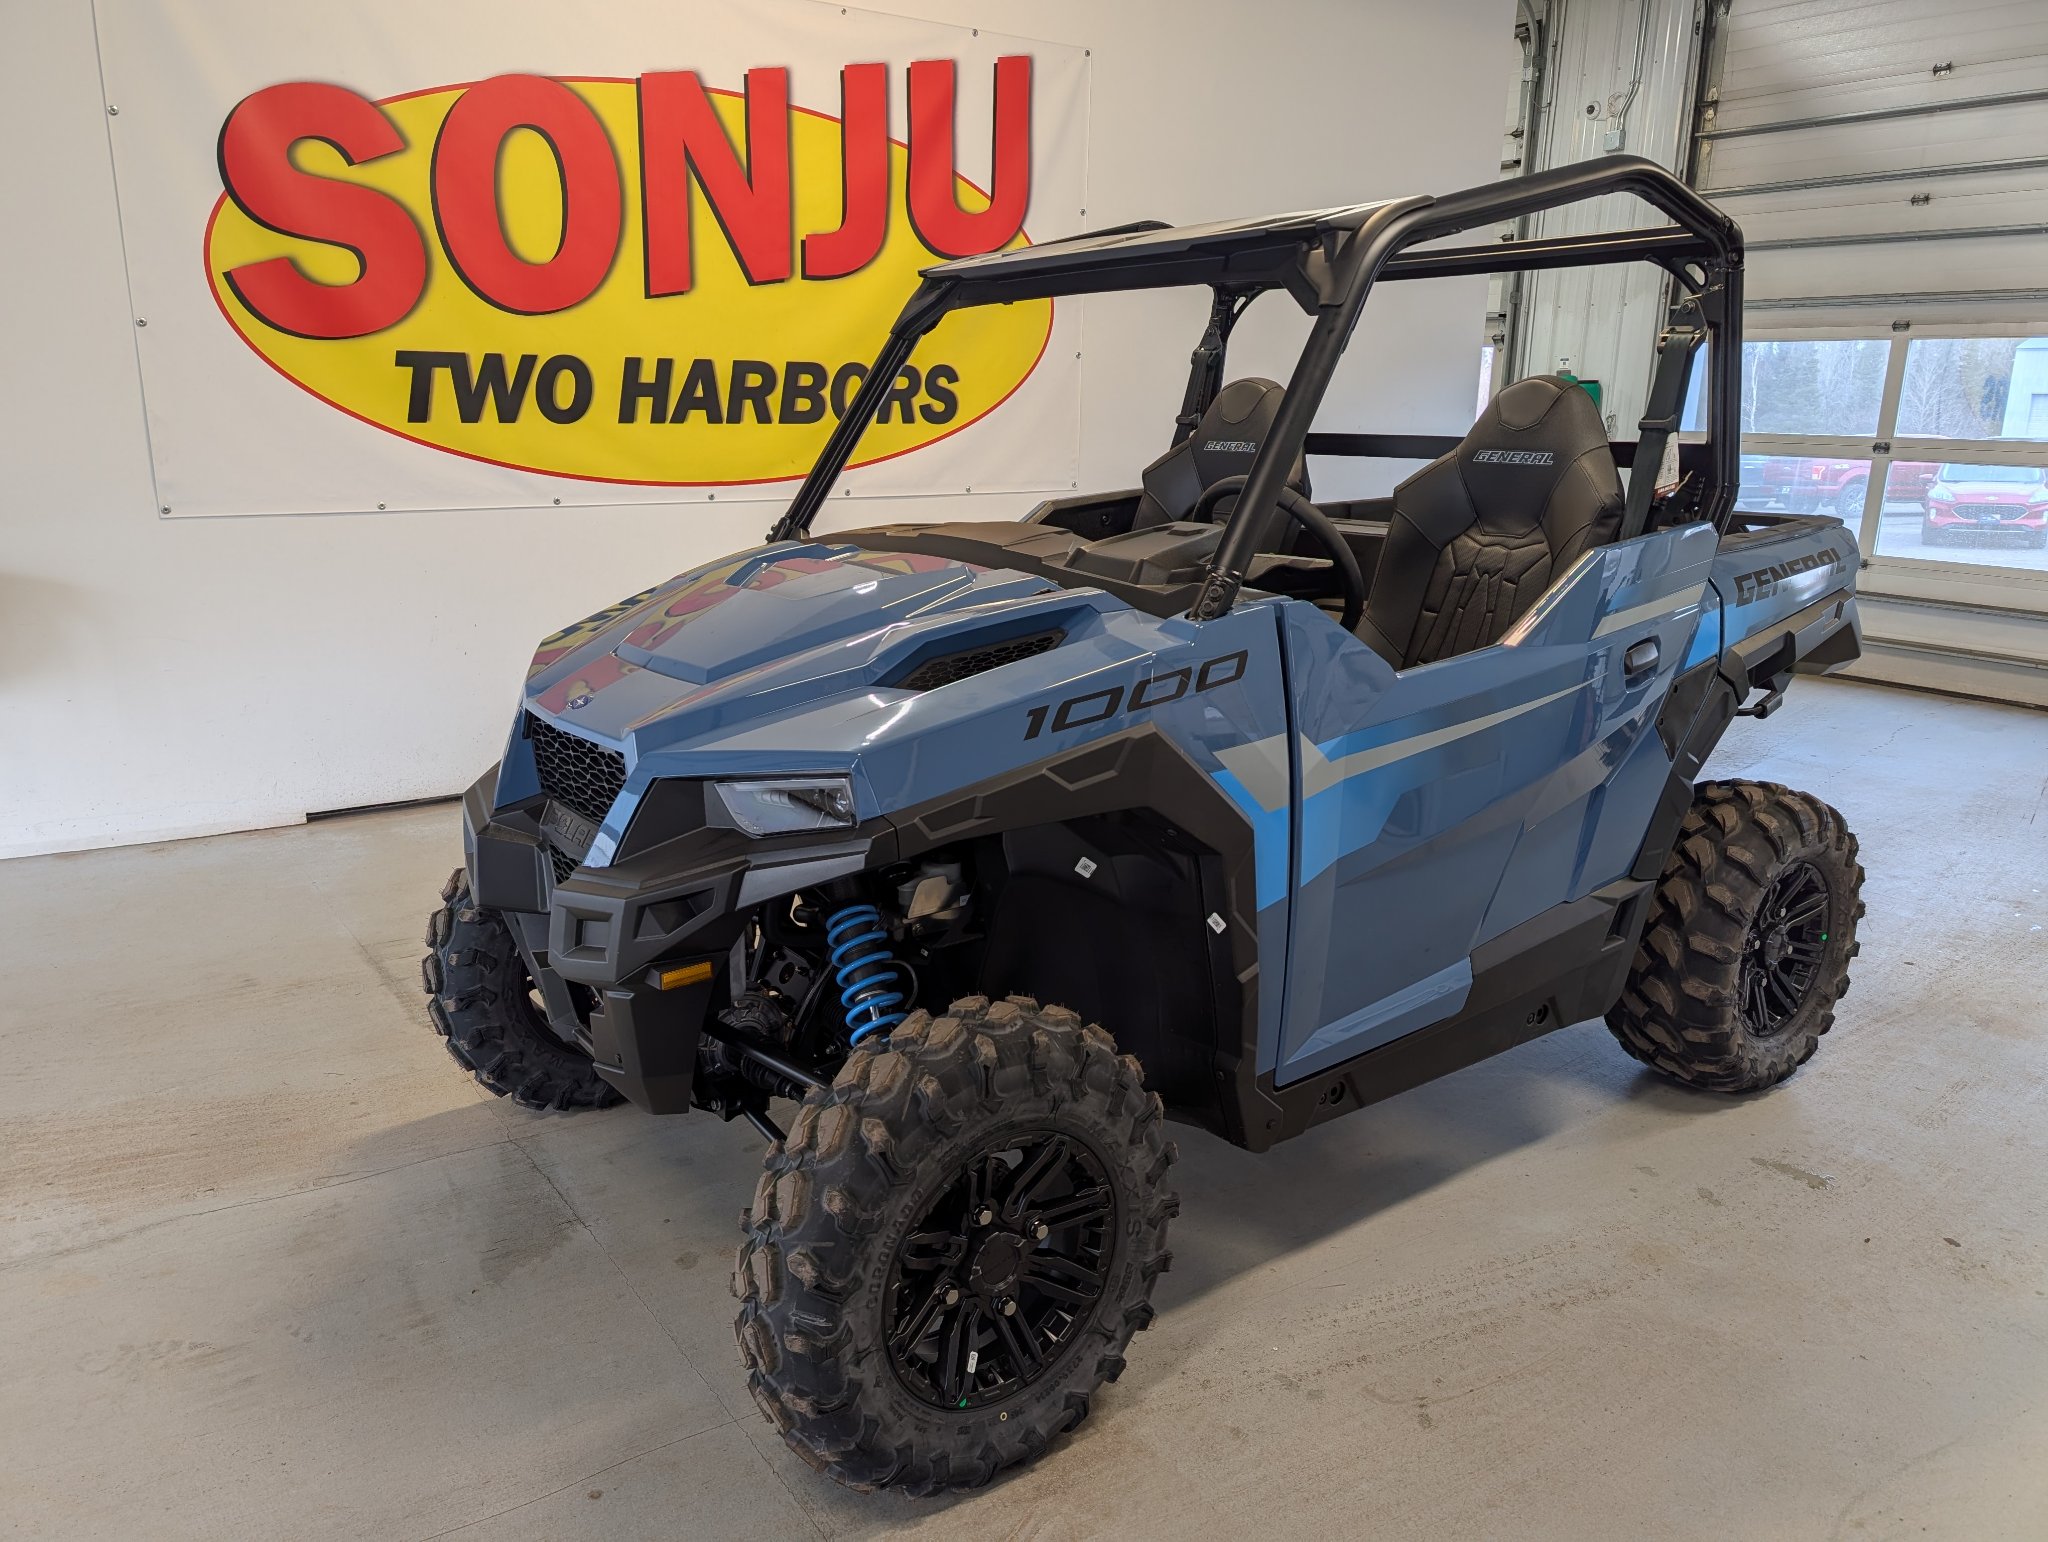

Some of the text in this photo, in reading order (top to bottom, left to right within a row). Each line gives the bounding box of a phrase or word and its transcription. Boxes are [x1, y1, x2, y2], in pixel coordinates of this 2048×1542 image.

[217, 55, 1032, 340] SONJU
[395, 350, 960, 424] TWO HARBORS
[1203, 439, 1256, 453] GENERAL
[1472, 449, 1554, 466] GENERAL
[1733, 547, 1847, 608] GENERAL
[1024, 649, 1248, 741] 1000
